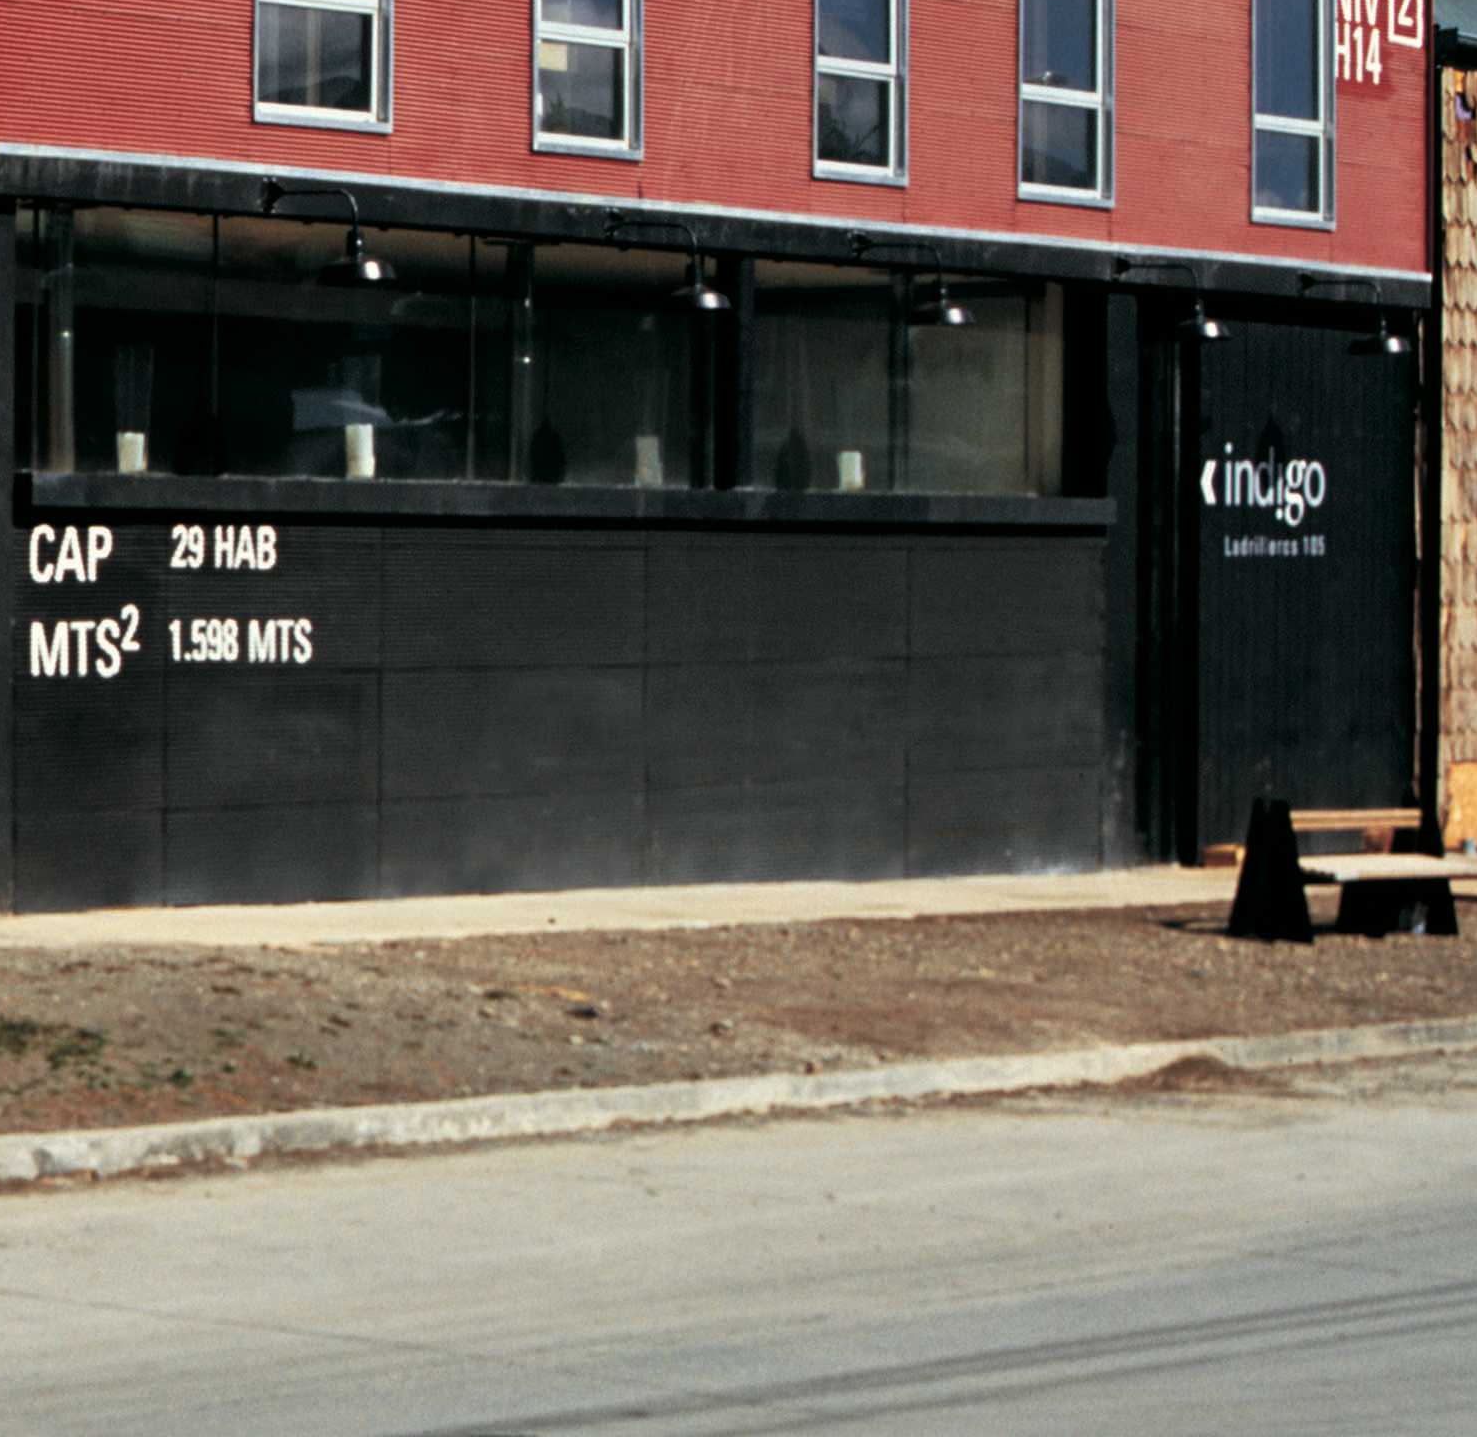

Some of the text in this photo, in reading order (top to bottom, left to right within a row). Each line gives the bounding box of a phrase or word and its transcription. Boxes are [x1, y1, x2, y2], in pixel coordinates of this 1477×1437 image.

[1335, 22, 1383, 85] H14
[1224, 441, 1326, 526] indigo
[29, 523, 277, 583] CAP 29 HAB
[168, 618, 240, 662] 1.598
[248, 618, 314, 664] MTS
